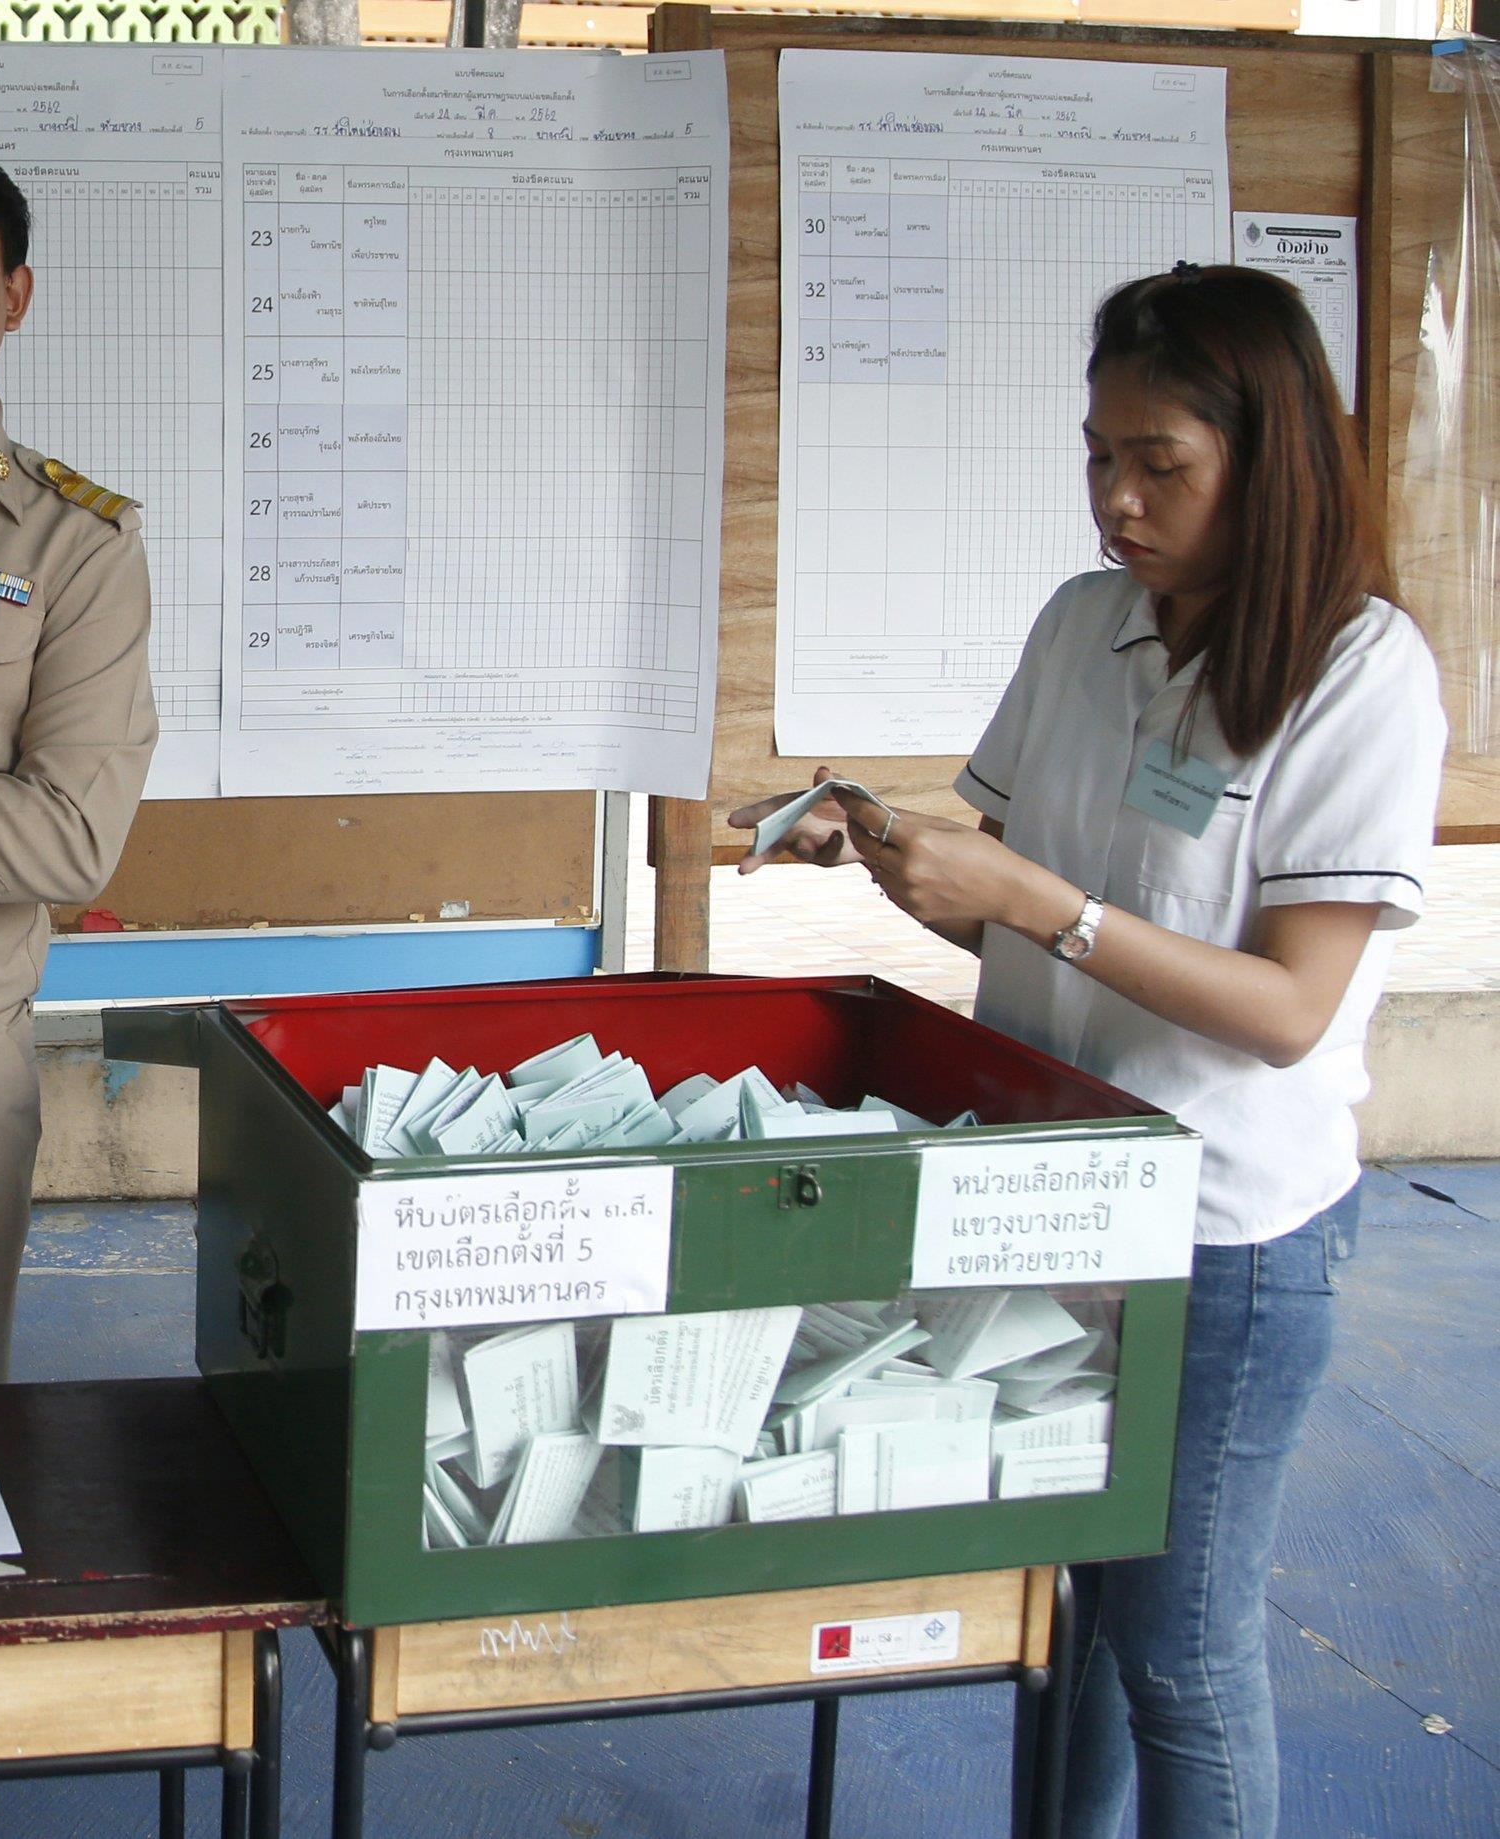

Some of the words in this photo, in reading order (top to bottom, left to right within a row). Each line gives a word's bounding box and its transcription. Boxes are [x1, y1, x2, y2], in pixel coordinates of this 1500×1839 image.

[33, 100, 60, 113] 2562
[529, 108, 557, 121] 2562
[195, 117, 204, 130] 5
[488, 127, 494, 139] 8
[685, 123, 693, 134] 5
[1018, 124, 1024, 136] 8
[1190, 131, 1197, 142] 5
[444, 148, 514, 158] กรุงเทพมหานคร
[982, 144, 1041, 154] กรุงเทพมหานคร
[15, 167, 79, 176] ช่องขีดคะแนน
[189, 170, 220, 178] คะแนน
[1041, 169, 1096, 179] ช่องขีดคะแนน
[512, 175, 573, 184] ช่องขีดคะแนน
[678, 175, 709, 184] คะแนน
[1186, 176, 1212, 184] คะแนน
[194, 186, 212, 194] รวม
[684, 192, 700, 200] รวม
[364, 217, 387, 228] ครูไทย
[805, 219, 825, 234] 30
[280, 226, 310, 234] นายกวิน
[251, 230, 273, 246] 23
[1277, 238, 1329, 255] ตัวอย่าง
[352, 249, 399, 260] เพื่อประชาชน
[805, 282, 825, 297] 32
[252, 297, 273, 313] 24
[805, 346, 825, 361] 33
[252, 364, 274, 380] 25
[351, 366, 401, 375] พลังไทยรักไทย
[279, 426, 320, 436] นายอนุรักษ์
[250, 432, 272, 448] 26
[348, 434, 401, 443] พลังท้องถิ่นไทย
[251, 500, 272, 515] 27
[357, 501, 391, 510] มติประชา
[249, 566, 271, 581] 28
[343, 565, 402, 576] ภาคีเครือข่ายไทย
[249, 632, 270, 648] 29
[348, 631, 394, 642] เศรษฐกิจใหม่
[953, 1151, 1128, 1196] หน่วยเลือกตั้งที่
[1140, 1161, 1157, 1189] 8
[952, 1202, 1111, 1237] แขวงบางกะปิ
[397, 1223, 565, 1271] เขตเลือกตั้งที่
[577, 1237, 593, 1261] 5
[949, 1243, 1103, 1274] เขตห้วยขวาง
[395, 1280, 606, 1320] กรุงเทพมหานคร
[643, 1328, 668, 1404] บัตรเลือกตั้ง
